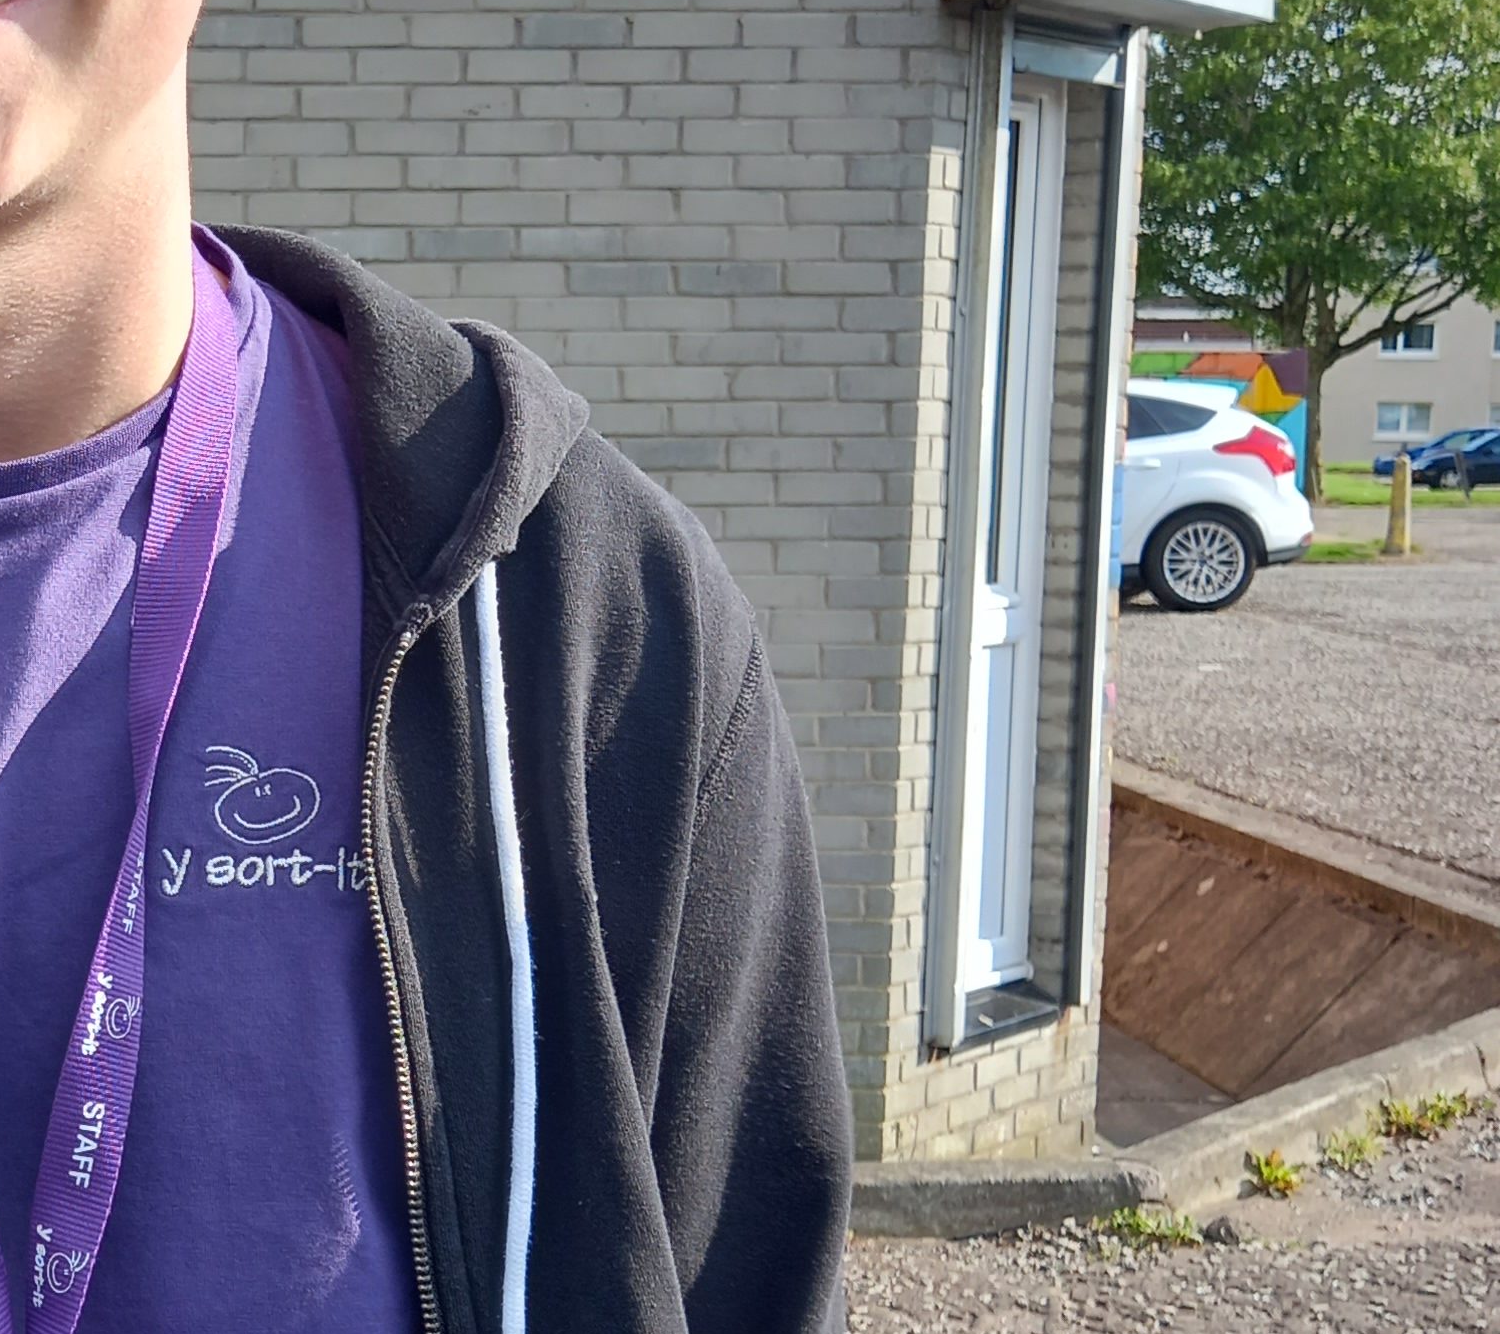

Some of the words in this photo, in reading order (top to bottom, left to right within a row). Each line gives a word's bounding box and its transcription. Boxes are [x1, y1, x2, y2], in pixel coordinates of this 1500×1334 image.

[122, 851, 145, 935] STAFF
[161, 847, 192, 896] y
[68, 1101, 106, 1189] STAFF
[36, 1224, 53, 1242] y
